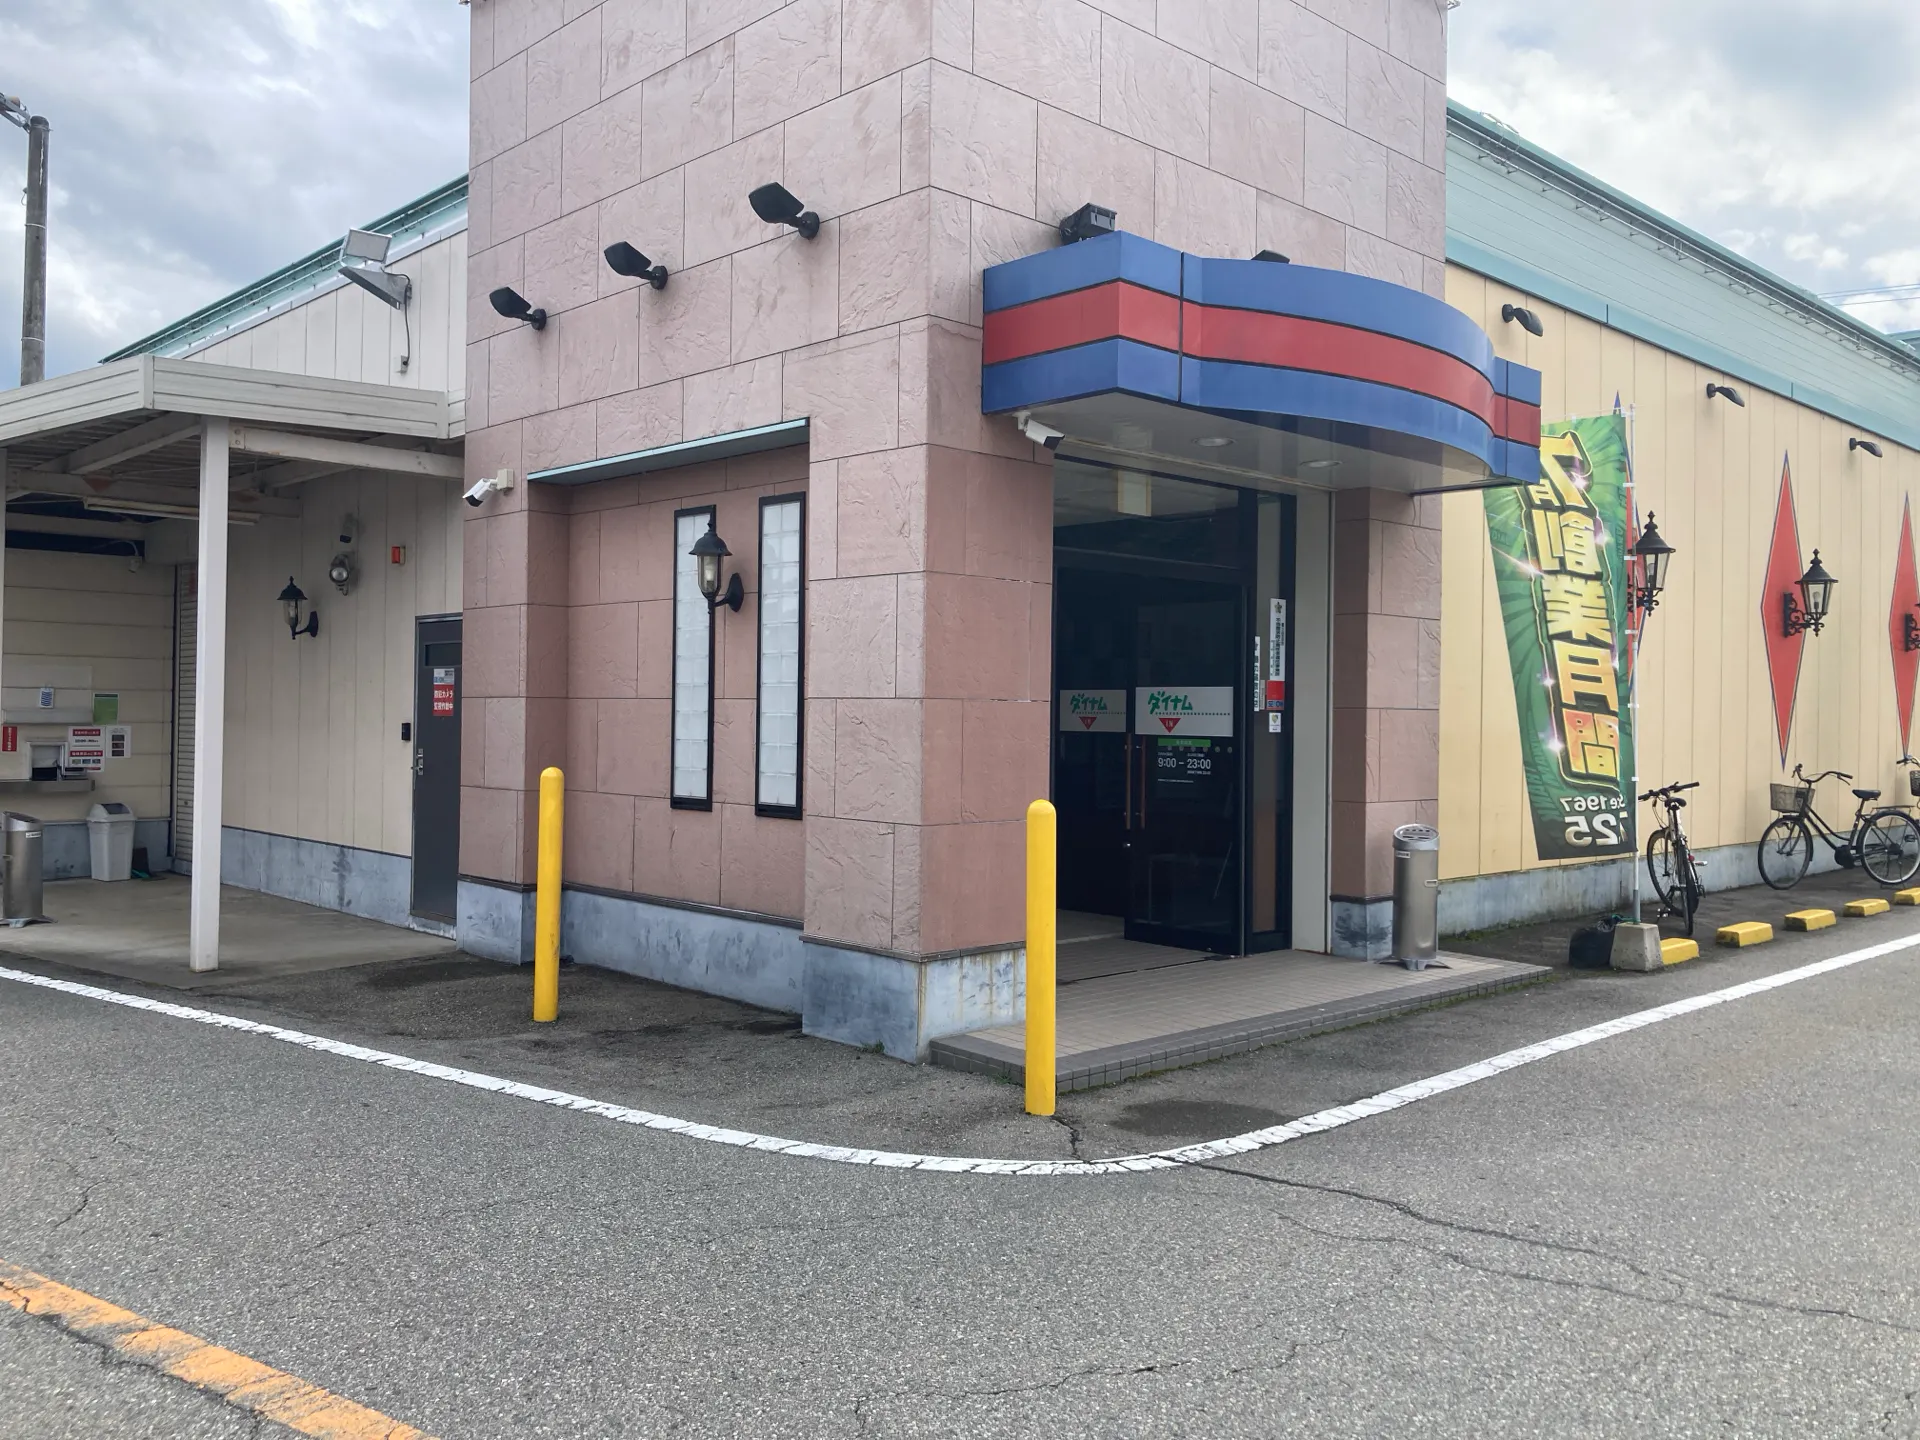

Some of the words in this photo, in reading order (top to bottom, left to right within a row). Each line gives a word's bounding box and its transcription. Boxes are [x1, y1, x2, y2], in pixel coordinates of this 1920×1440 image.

[1070, 692, 1108, 715] ダイナム
[1147, 690, 1194, 715] ダイナム
[1157, 757, 1177, 768] 9:00
[1186, 758, 1212, 770] 23:00
